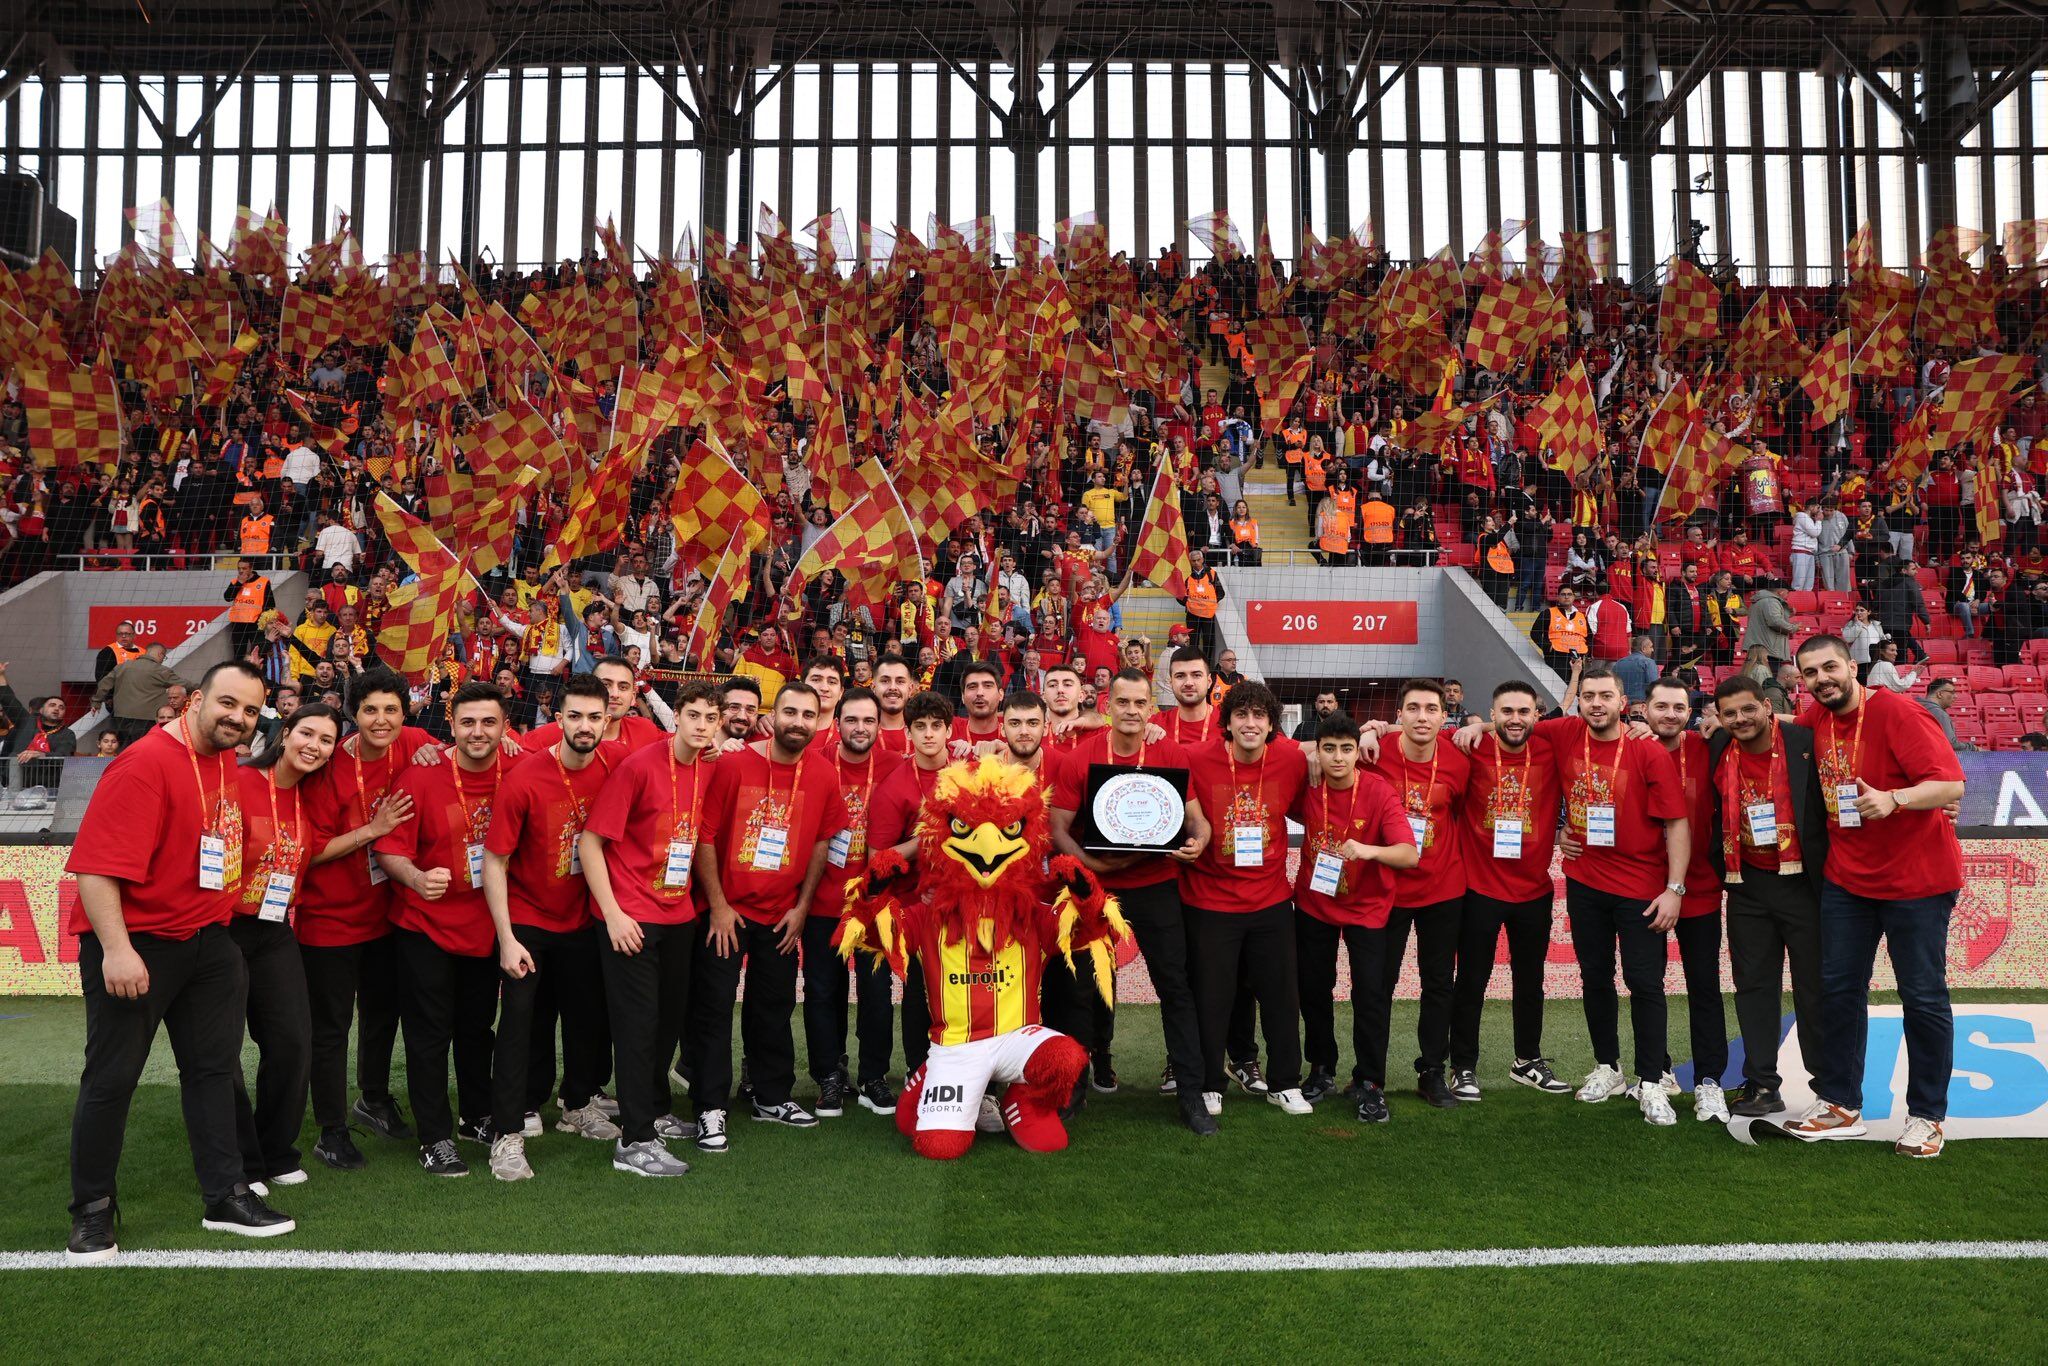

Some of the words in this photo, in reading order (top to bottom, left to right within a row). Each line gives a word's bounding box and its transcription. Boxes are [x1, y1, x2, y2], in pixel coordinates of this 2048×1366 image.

[1614, 568, 1632, 577] YAL
[124, 619, 157, 635] 05
[185, 619, 207, 635] 20
[1282, 615, 1318, 631] 206
[1352, 615, 1388, 631] 207
[949, 969, 1005, 985] euroil
[923, 1085, 963, 1106] HDI
